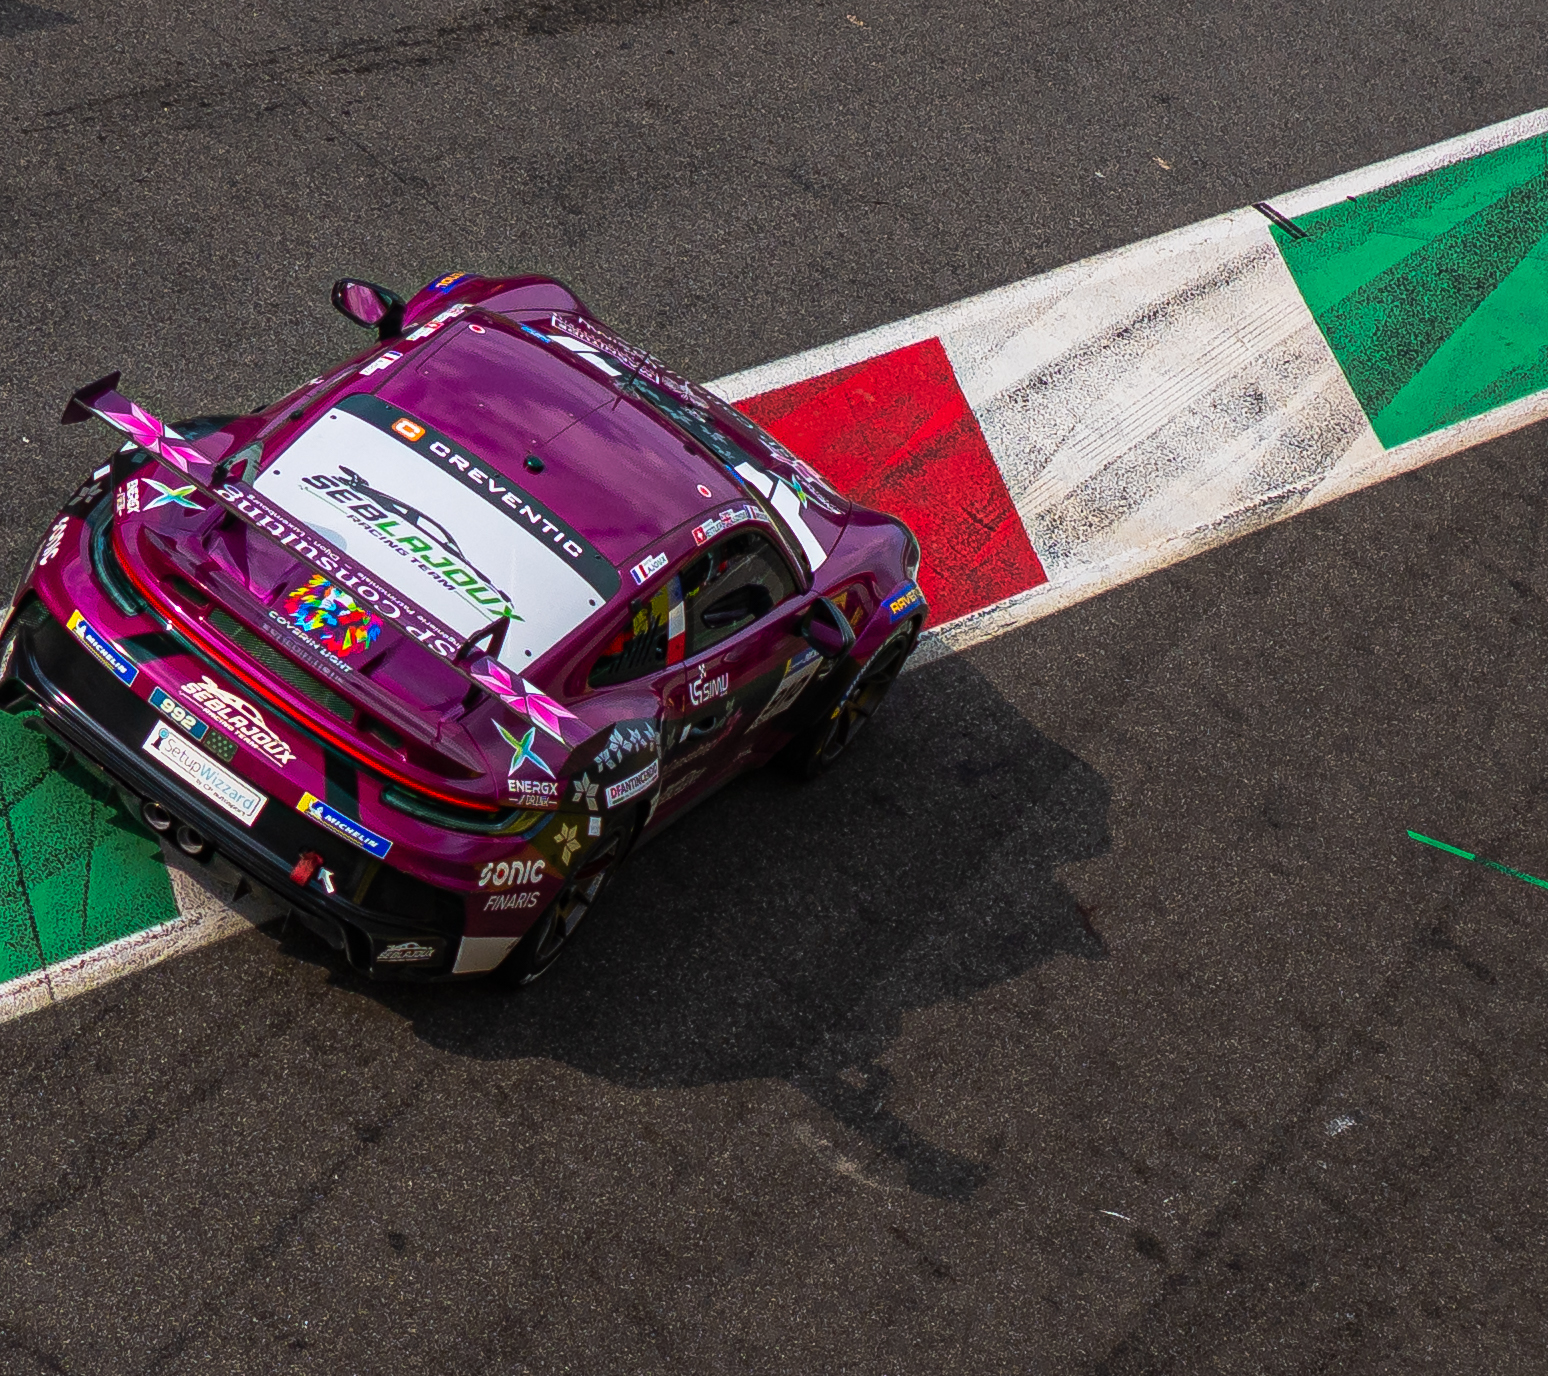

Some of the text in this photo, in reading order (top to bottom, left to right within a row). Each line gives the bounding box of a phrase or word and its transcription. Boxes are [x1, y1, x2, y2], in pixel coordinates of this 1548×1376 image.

[429, 441, 584, 558] CREVENTIC
[301, 473, 523, 622] SEBLAJOUX
[346, 512, 456, 593] RACING TEAM
[214, 482, 456, 659] SP Consulting
[84, 634, 128, 675] MICHELIN
[159, 699, 197, 732] 992
[181, 682, 296, 764] SEBLAJOUX
[508, 779, 559, 796] ENERGX
[326, 813, 380, 849] MICHELIN
[478, 859, 546, 886] SONIC
[483, 892, 541, 911] FINARIS
